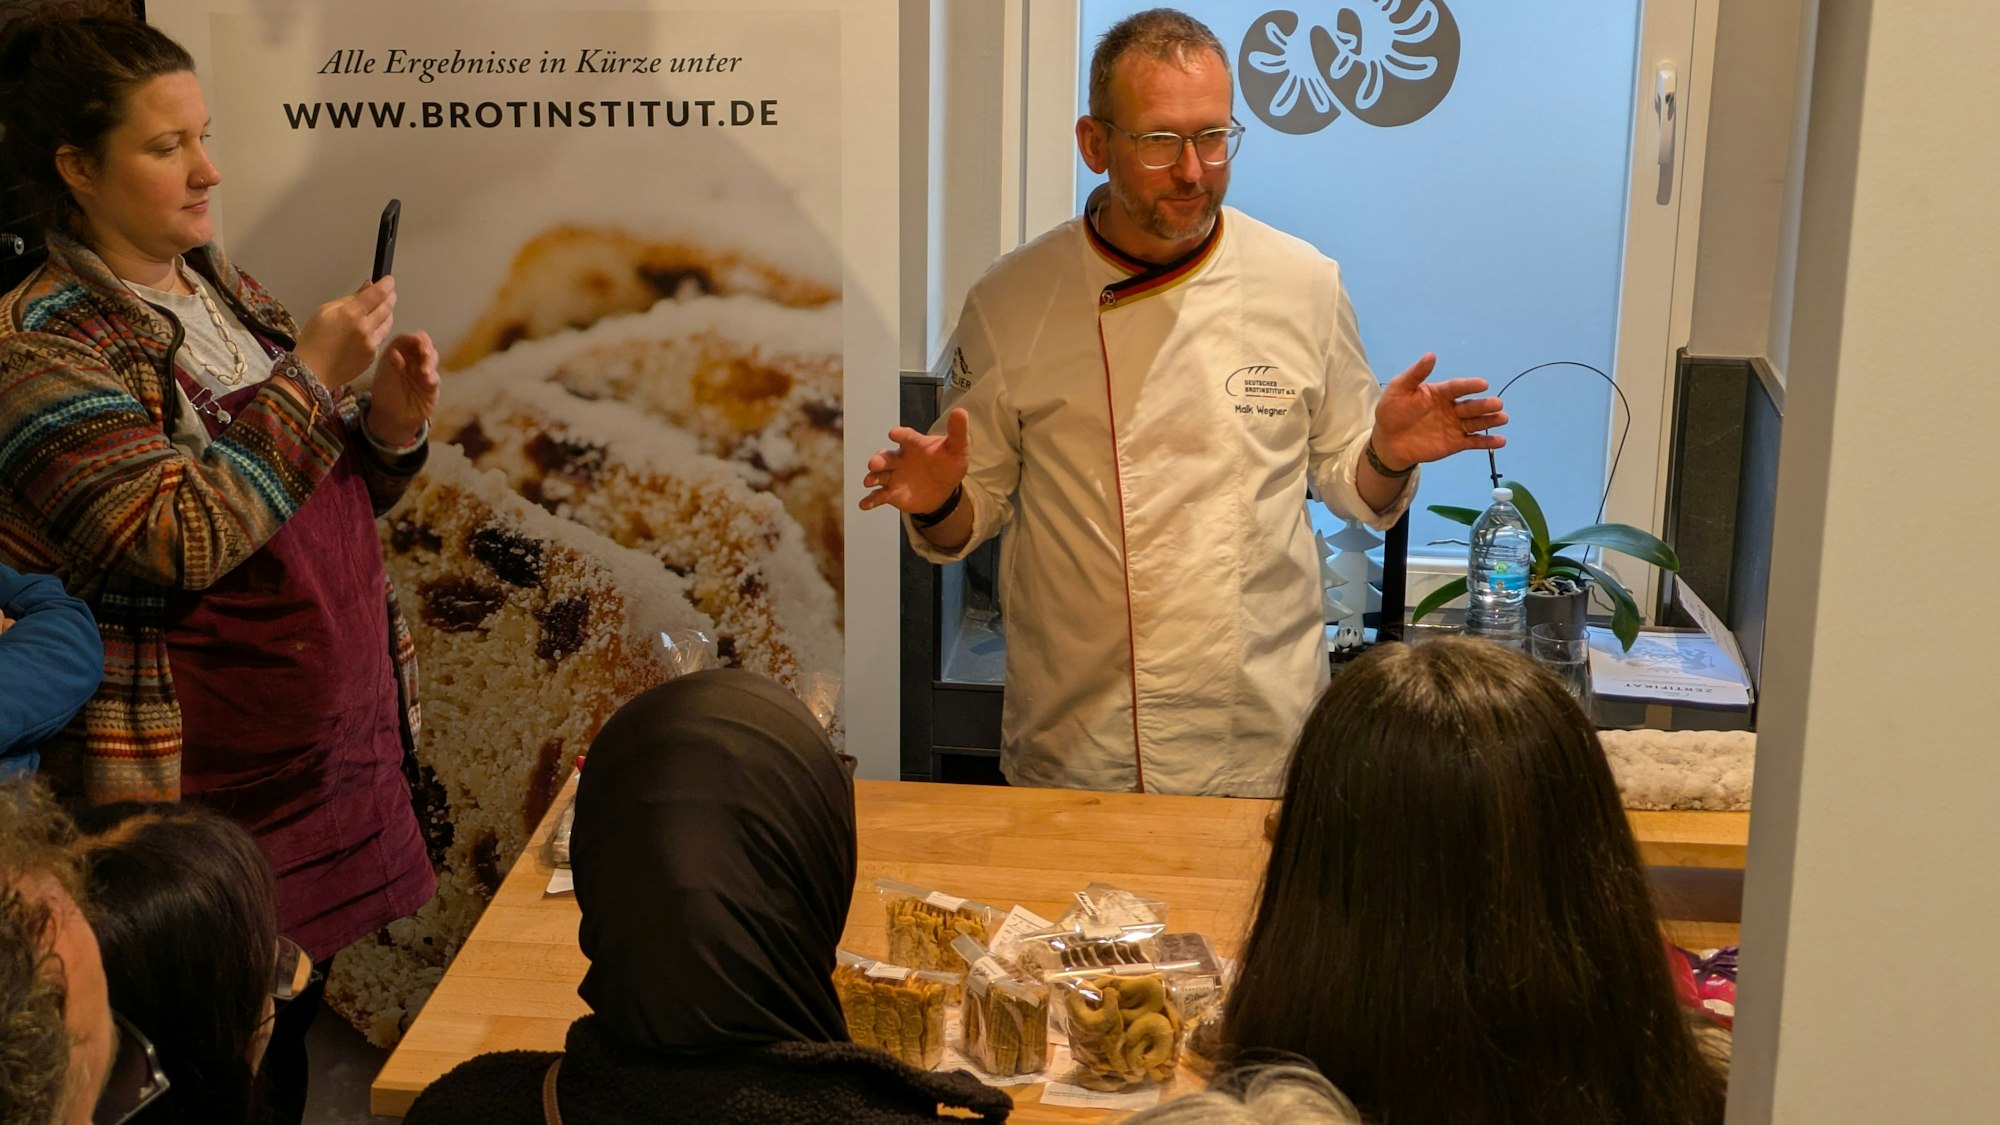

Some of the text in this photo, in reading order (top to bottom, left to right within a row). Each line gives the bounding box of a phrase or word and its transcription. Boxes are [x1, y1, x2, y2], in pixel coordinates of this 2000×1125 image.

[317, 48, 743, 84] Alle Ergebnisse in Kürze unter
[282, 99, 779, 130] WWW.BROTINSTITUT.DE
[1245, 387, 1285, 395] BROTINSTITUT
[1257, 405, 1287, 417] Wegner
[1624, 683, 1713, 693] ZERTIFIKAT
